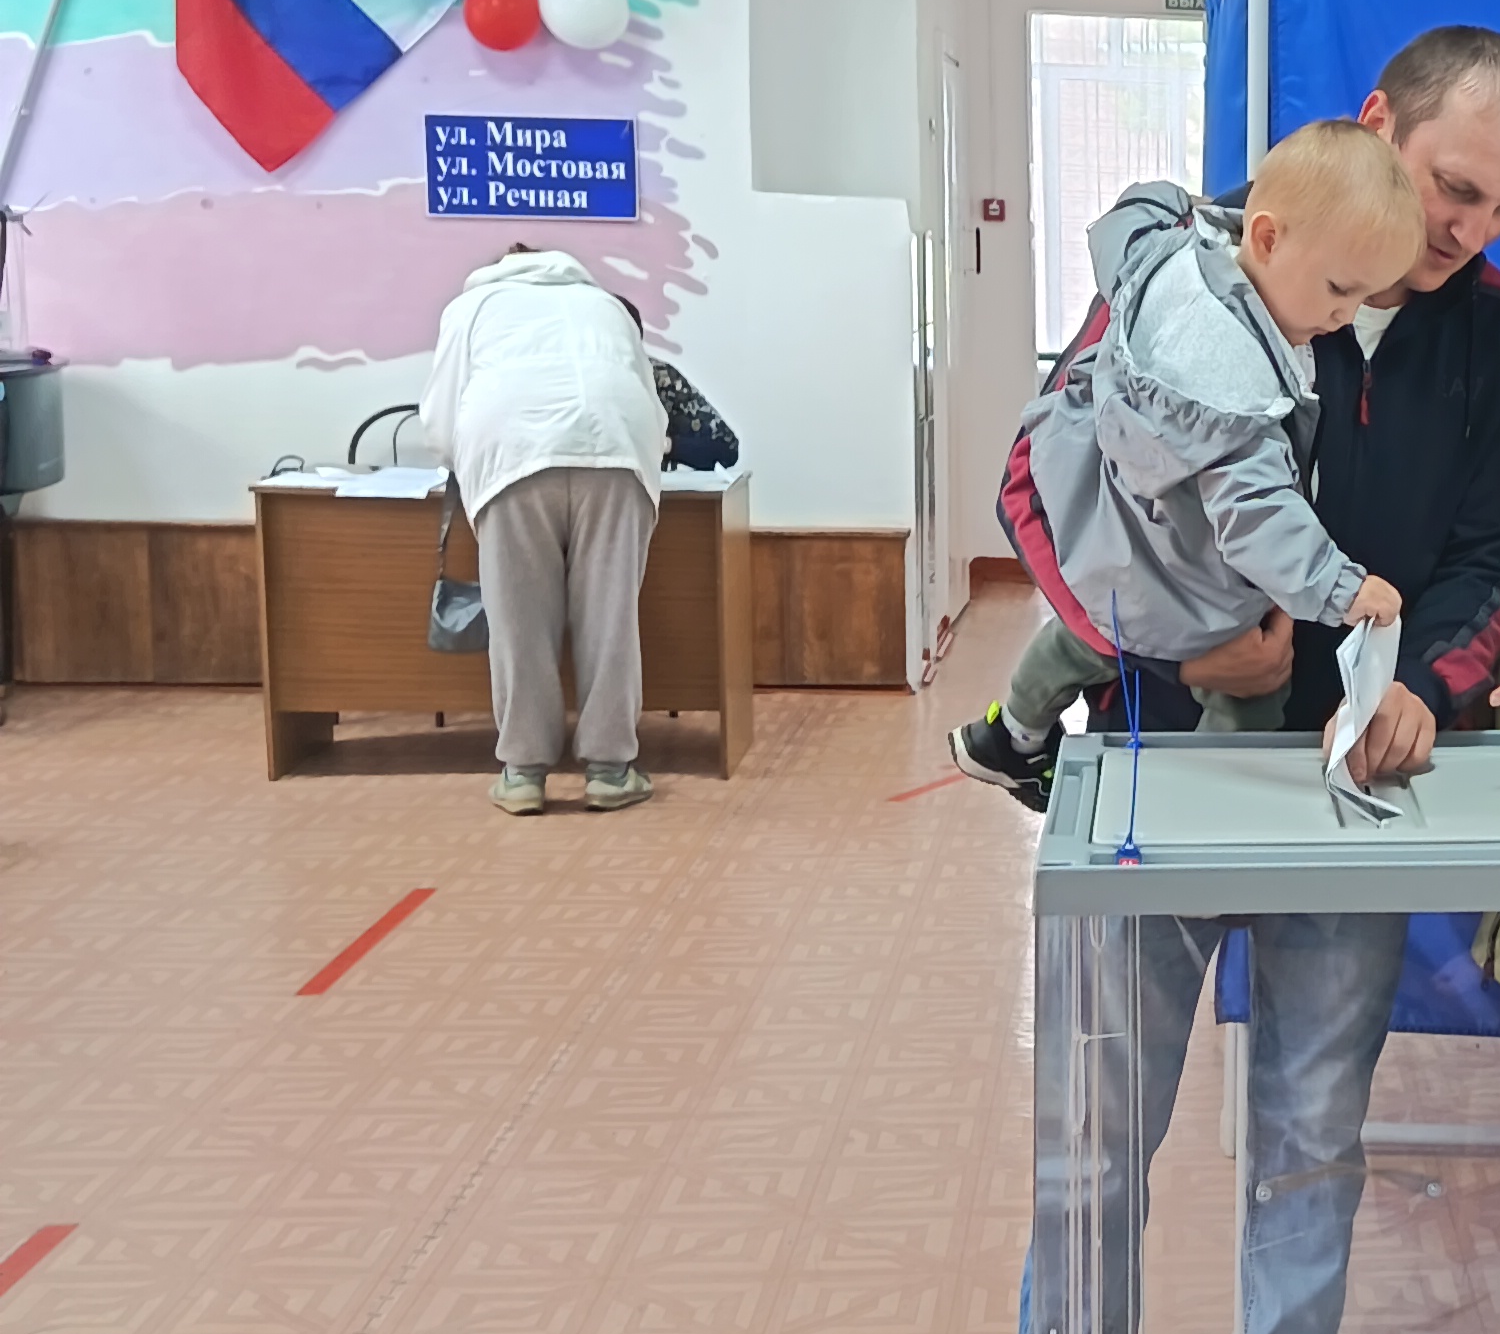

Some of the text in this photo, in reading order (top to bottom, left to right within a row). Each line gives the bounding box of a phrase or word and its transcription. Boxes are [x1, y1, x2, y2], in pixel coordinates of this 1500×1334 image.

[435, 120, 567, 154] ул. Мира
[436, 151, 626, 182] ул. Мостовая
[437, 181, 588, 211] ул. Речная
